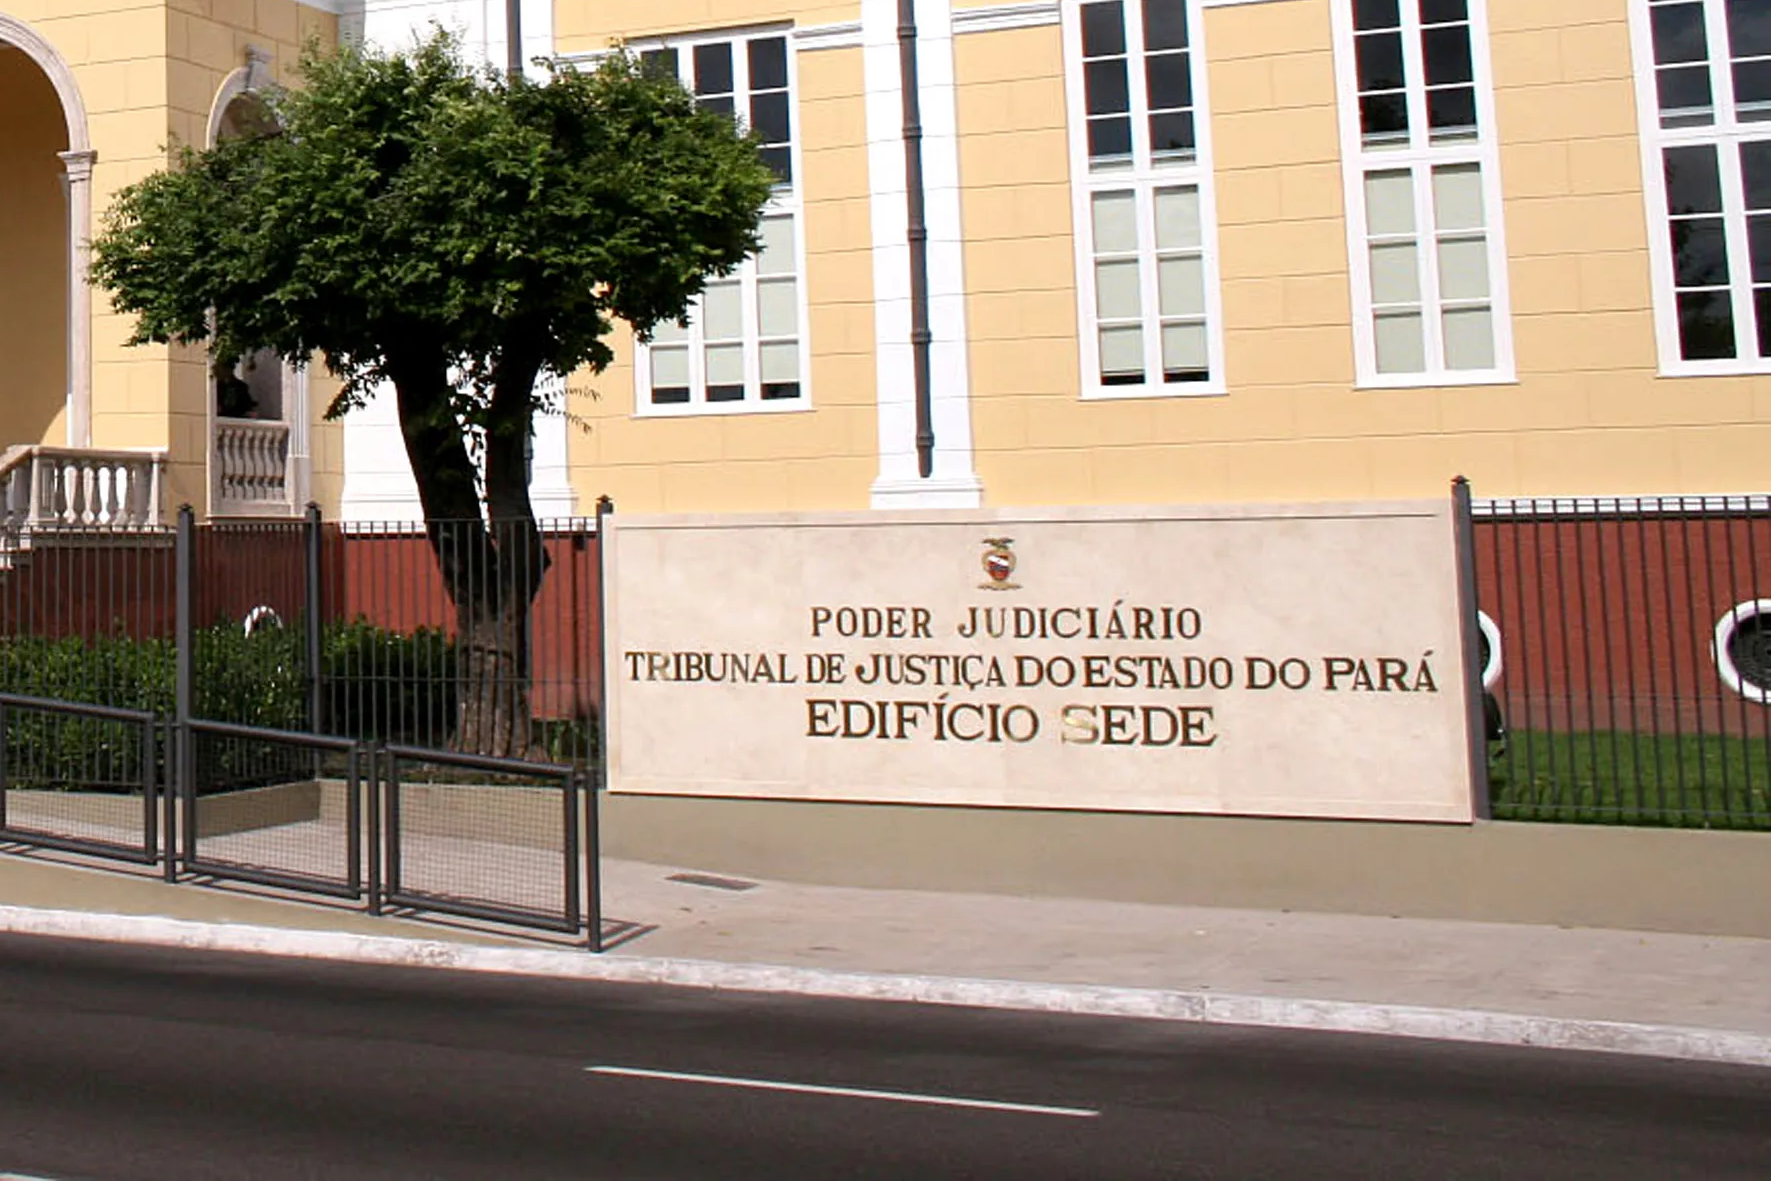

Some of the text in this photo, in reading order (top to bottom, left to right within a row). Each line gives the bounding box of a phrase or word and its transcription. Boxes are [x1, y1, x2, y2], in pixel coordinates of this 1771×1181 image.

[810, 599, 1203, 641] PODER JUDICIÁRIO
[625, 650, 1439, 694] TRIBUNAL DE JUSTIÇA DO ESTADO DO PARÁ
[806, 694, 1218, 748] EDIFÍCIO SEDE
